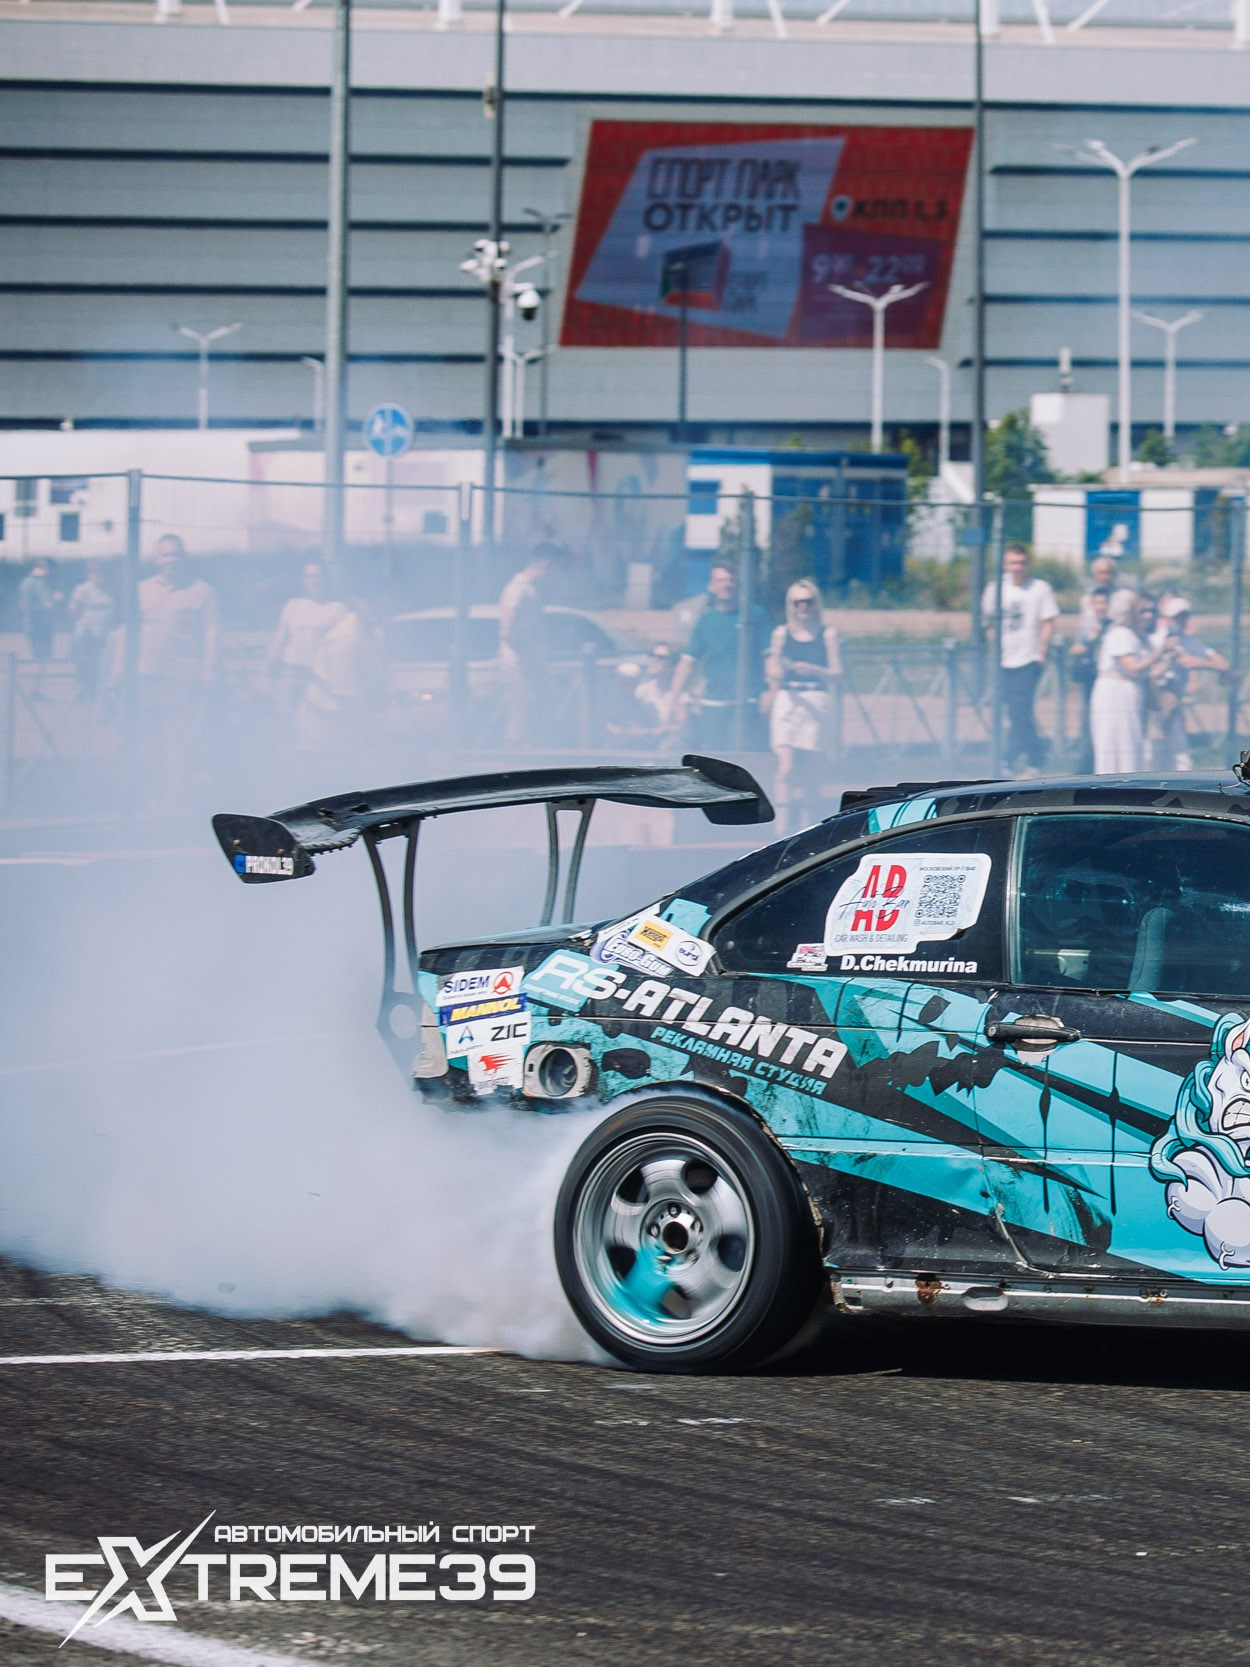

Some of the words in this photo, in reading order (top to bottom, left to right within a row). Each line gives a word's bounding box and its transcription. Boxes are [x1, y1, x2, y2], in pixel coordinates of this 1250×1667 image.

[643, 202, 799, 233] ОТКРЫТ
[840, 954, 978, 973] D.Chekmurina
[444, 975, 490, 993] SIDEM
[530, 953, 848, 1079] RS-ATLANTA
[491, 1022, 528, 1042] ZIC
[650, 1026, 755, 1070] РЕКЛАМНАЯ
[754, 1061, 828, 1095] СТУДИЯ
